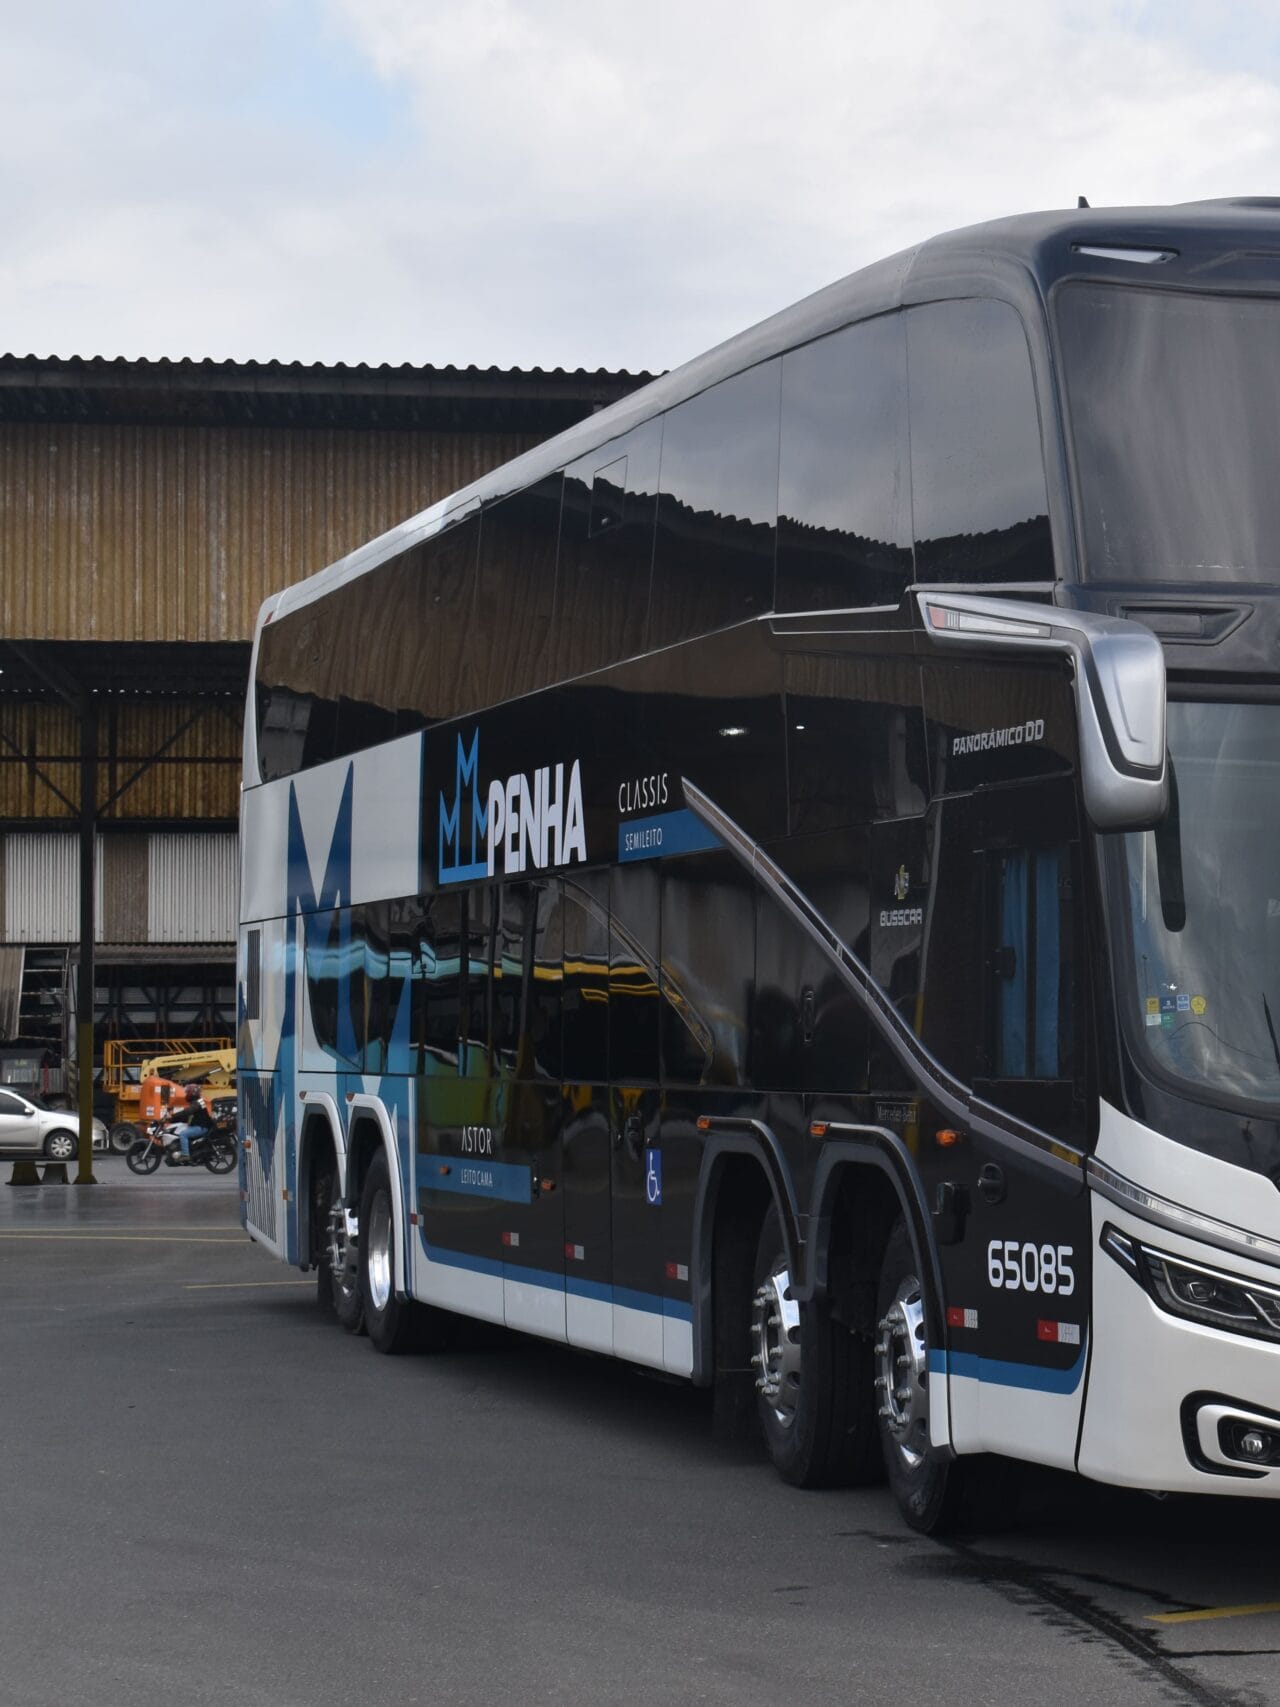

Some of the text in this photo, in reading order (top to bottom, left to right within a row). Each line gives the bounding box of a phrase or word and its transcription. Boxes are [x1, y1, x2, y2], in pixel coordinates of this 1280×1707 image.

[1025, 719, 1044, 742] DD
[618, 772, 668, 812] CLASSIS
[487, 759, 587, 877] PENHA
[625, 827, 663, 851] SEMILEITO
[880, 908, 922, 927] BUSSCAR
[461, 1125, 492, 1154] ASTOR
[987, 1240, 1075, 1296] 65085
